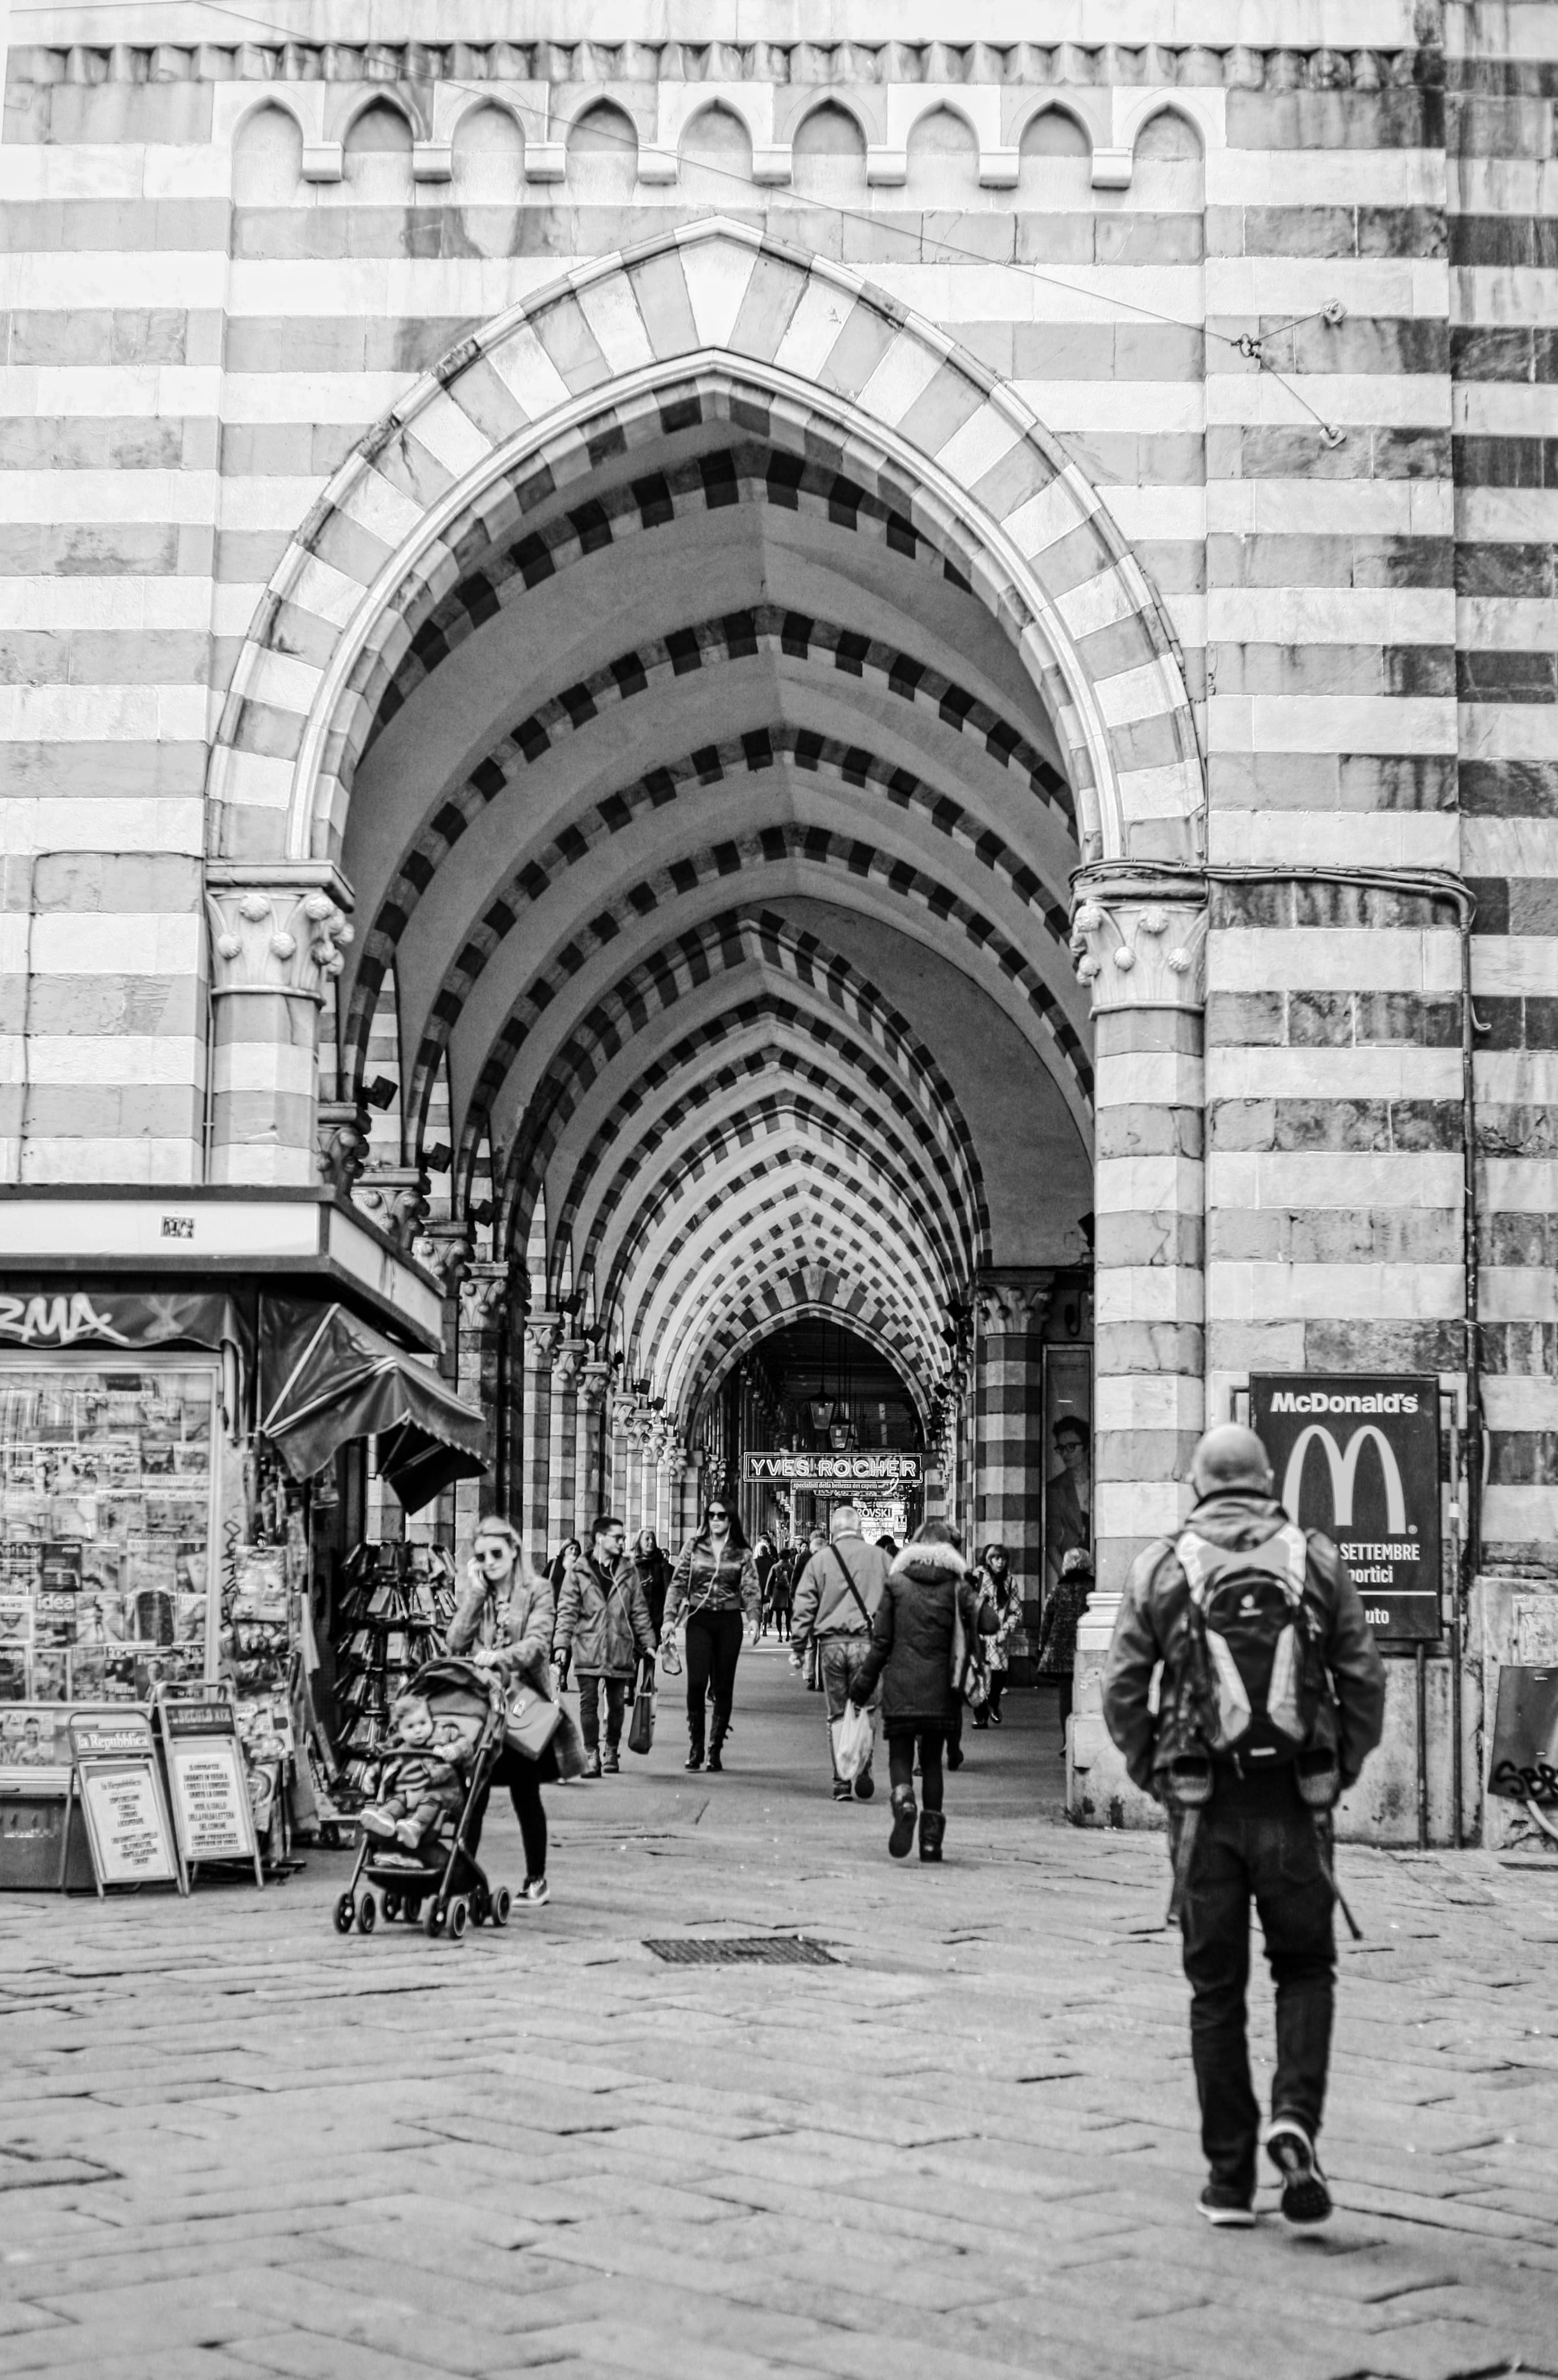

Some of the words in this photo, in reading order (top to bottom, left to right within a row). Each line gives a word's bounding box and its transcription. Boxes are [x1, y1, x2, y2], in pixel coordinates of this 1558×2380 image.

[1270, 1392, 1418, 1413] McDonald's
[750, 1459, 810, 1477] YVES
[818, 1459, 917, 1477] ROCHER
[857, 1508, 891, 1518] ROVSKI
[1340, 1543, 1420, 1560] SETTEMBRE
[37, 1594, 75, 1610] idea
[1365, 1608, 1390, 1624] uto
[88, 1732, 147, 1752] Repubblica
